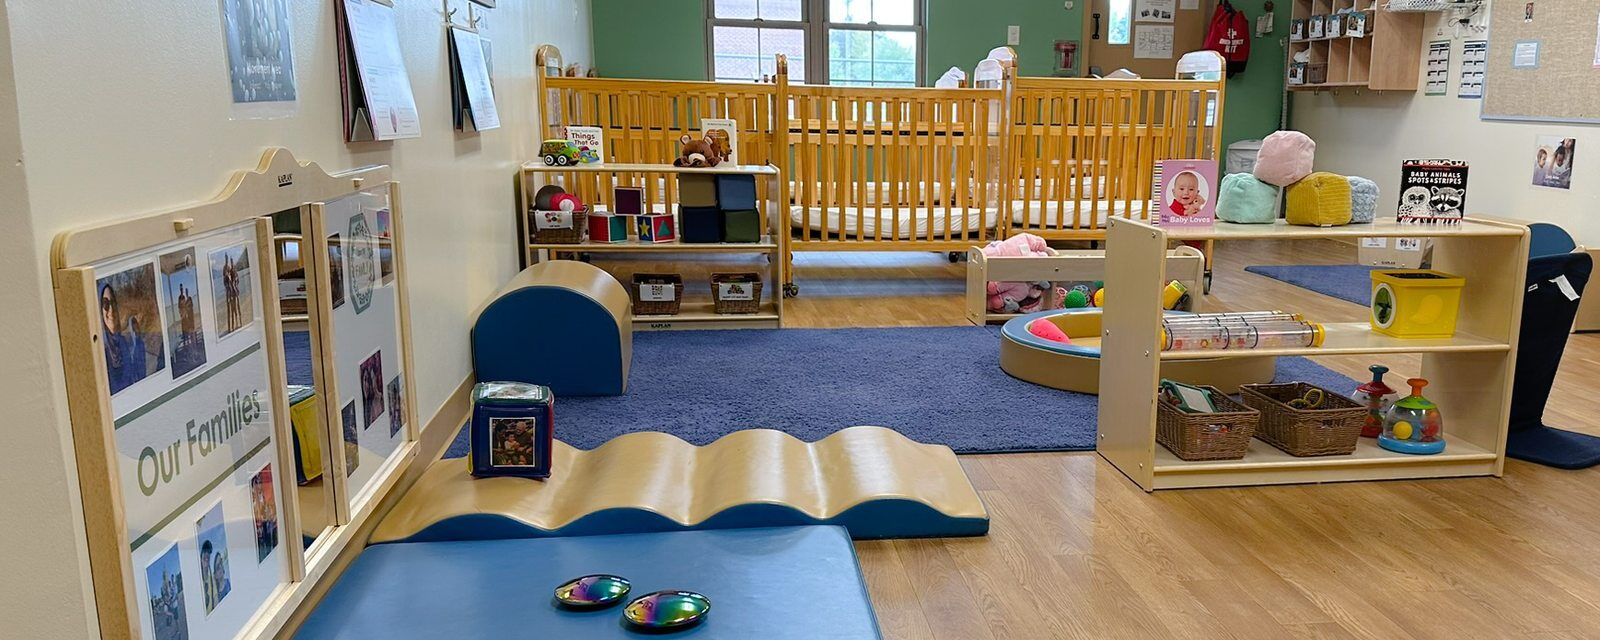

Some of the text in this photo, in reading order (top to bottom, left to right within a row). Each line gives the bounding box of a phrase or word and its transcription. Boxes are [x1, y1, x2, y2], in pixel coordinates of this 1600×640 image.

[1169, 215, 1189, 224] Baby
[138, 389, 261, 497] Our Families
